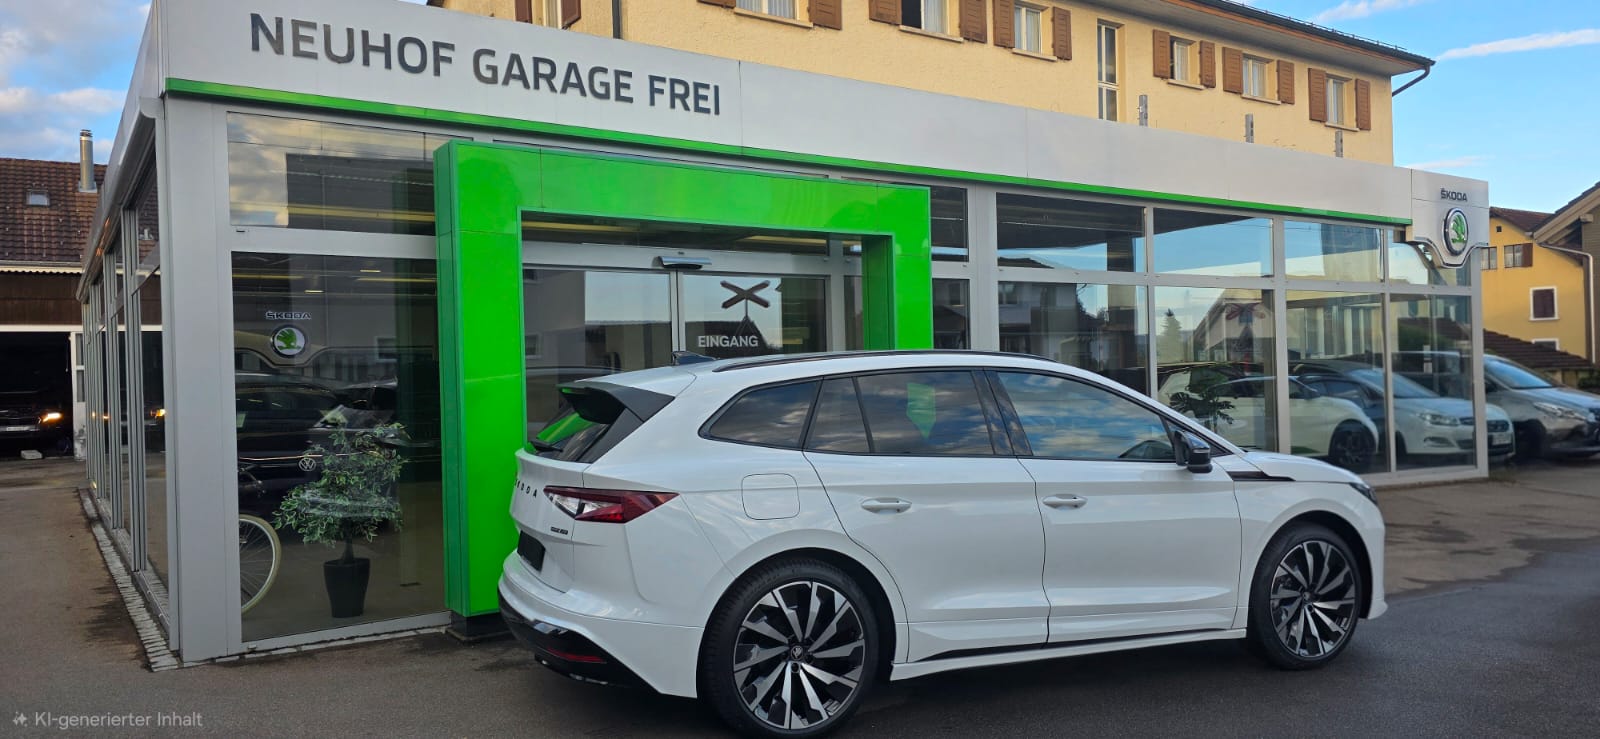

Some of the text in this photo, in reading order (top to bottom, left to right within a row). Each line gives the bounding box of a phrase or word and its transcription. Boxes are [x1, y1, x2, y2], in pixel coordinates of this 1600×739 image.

[250, 12, 720, 115] NEUHOF GARAGE FREI
[1440, 187, 1468, 202] ŠKODA
[265, 310, 312, 320] ŠKODA
[697, 335, 759, 348] EINGANG
